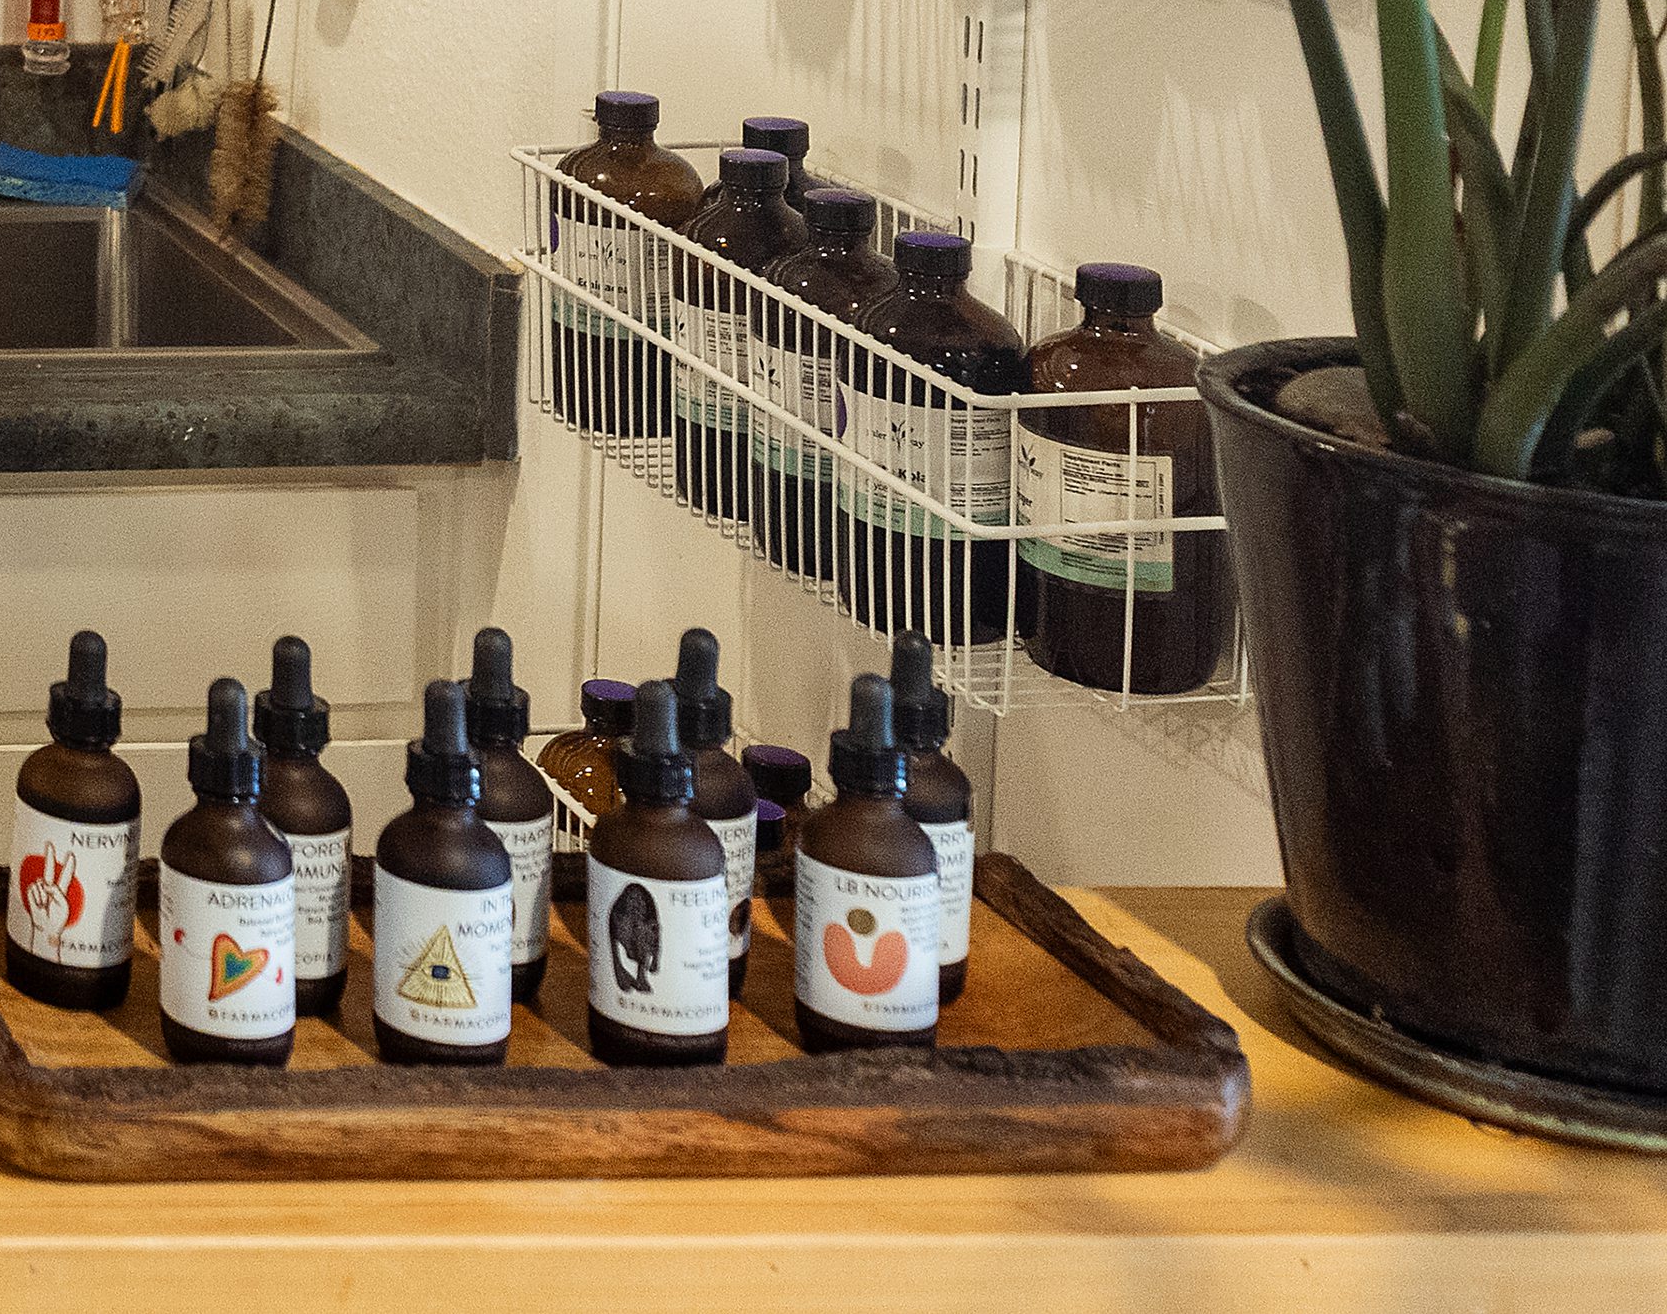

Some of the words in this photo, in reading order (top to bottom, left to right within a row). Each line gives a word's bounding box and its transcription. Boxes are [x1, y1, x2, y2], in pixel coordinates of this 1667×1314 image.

[1063, 453, 1100, 466] Supplement
[71, 832, 131, 849] NERVIN
[499, 896, 514, 913] TH
[670, 886, 728, 907] FEELIN
[456, 919, 514, 937] MOMEN
